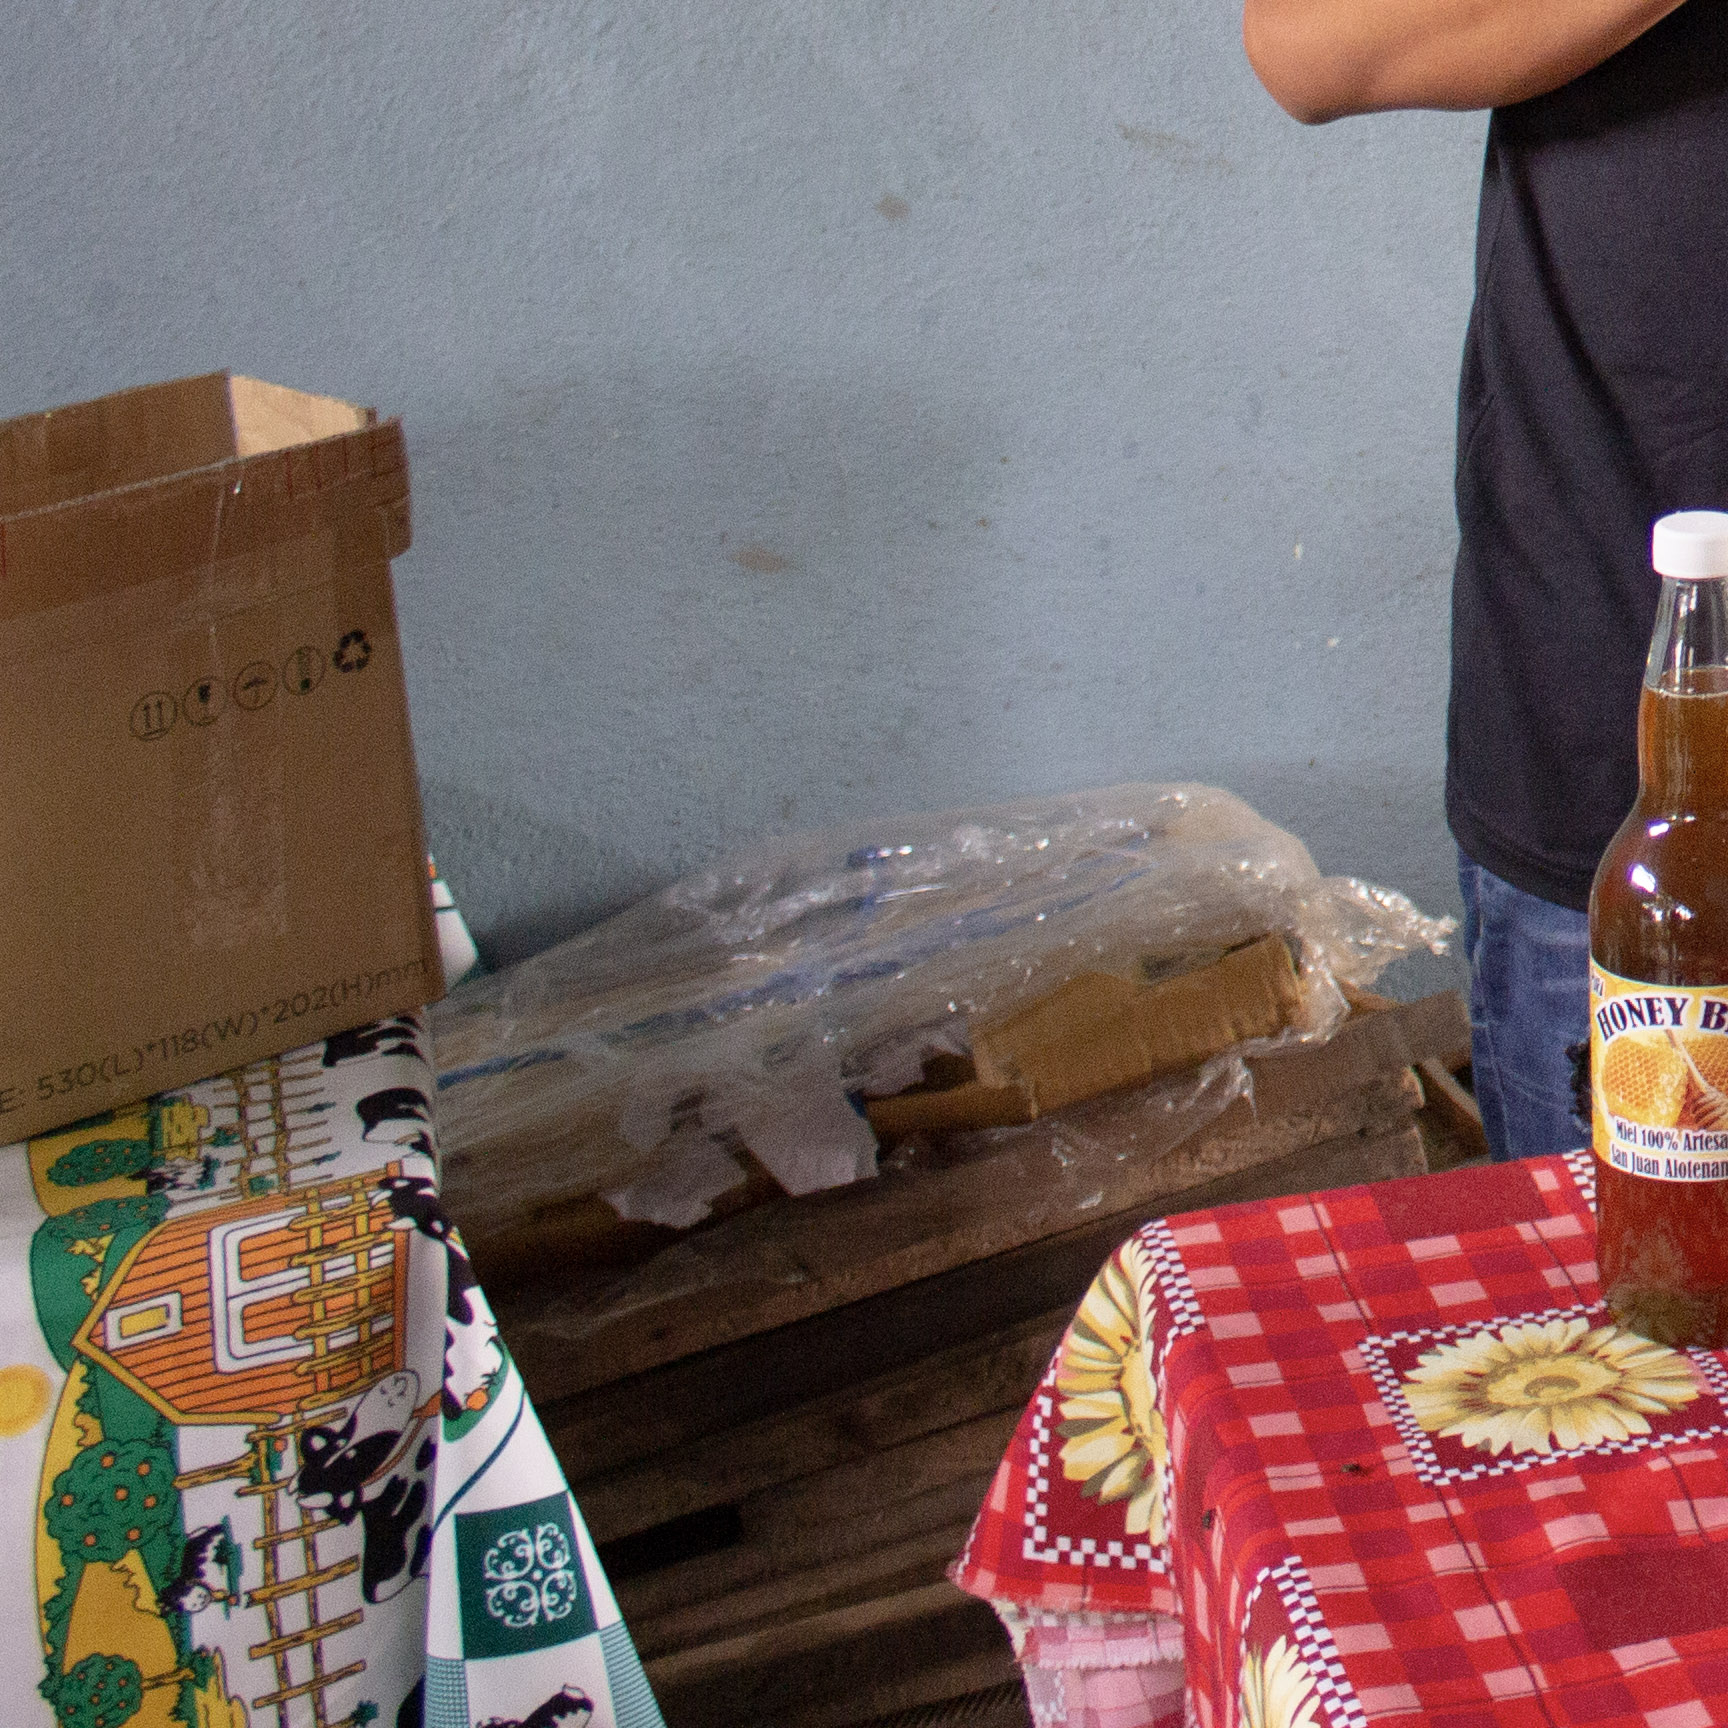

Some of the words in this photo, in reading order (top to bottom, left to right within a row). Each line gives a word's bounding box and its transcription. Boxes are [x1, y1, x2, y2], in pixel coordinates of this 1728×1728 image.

[1597, 997, 1690, 1042] HONEY
[1616, 1118, 1638, 1144] Miel
[1641, 1128, 1679, 1151] 100%
[1611, 1143, 1628, 1168] San
[1630, 1151, 1660, 1177] Juan
